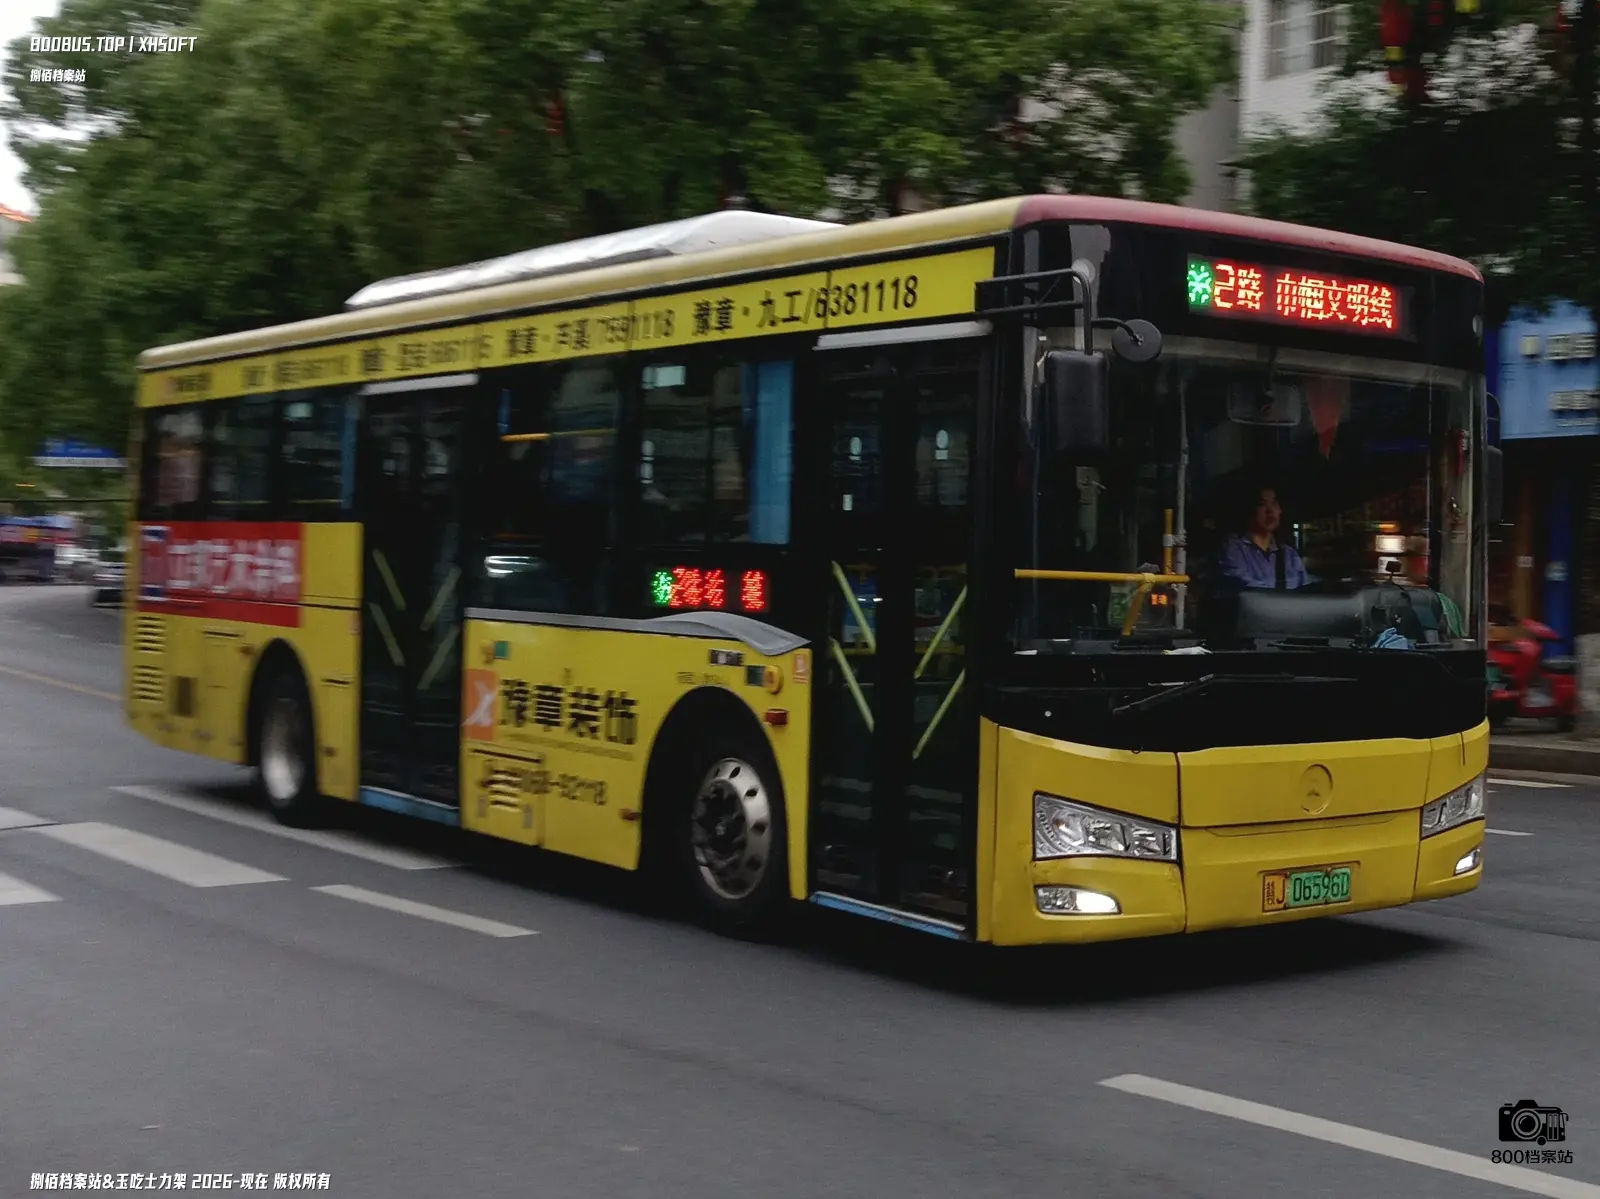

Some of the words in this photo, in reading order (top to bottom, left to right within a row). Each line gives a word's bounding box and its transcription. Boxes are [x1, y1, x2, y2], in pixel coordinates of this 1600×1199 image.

[1213, 263, 1264, 311] 2路
[1276, 272, 1393, 329] 巾帼文明线
